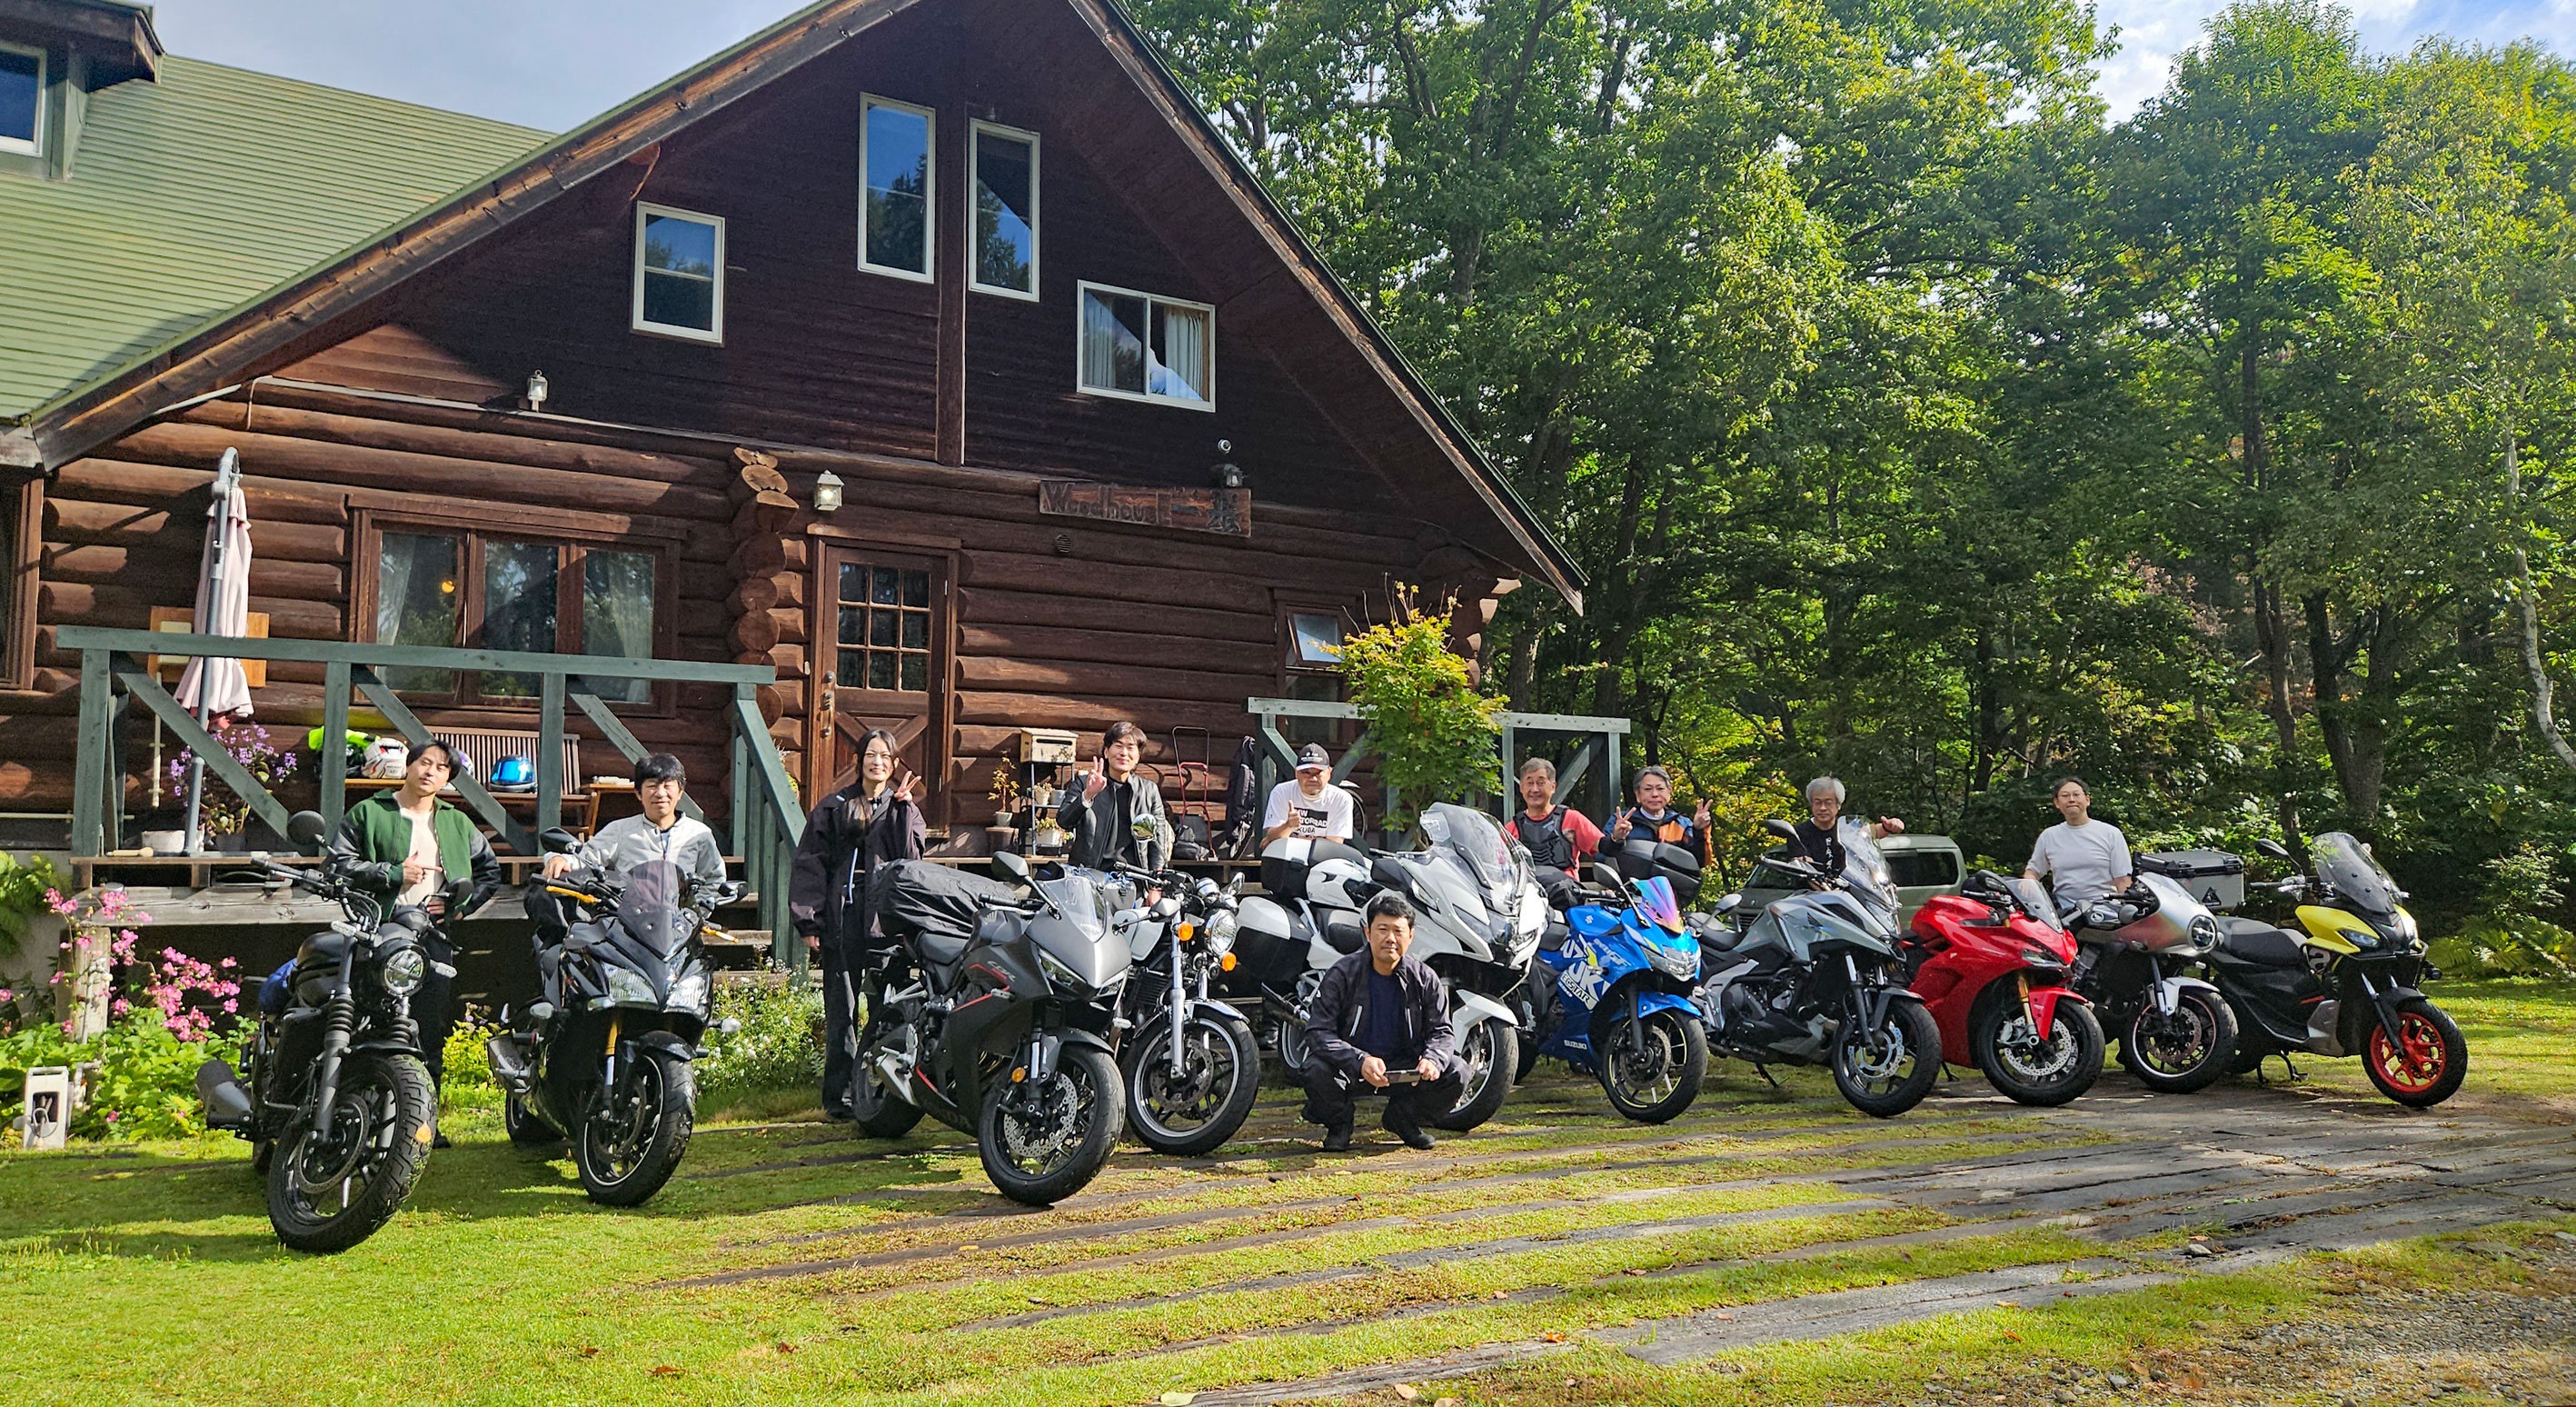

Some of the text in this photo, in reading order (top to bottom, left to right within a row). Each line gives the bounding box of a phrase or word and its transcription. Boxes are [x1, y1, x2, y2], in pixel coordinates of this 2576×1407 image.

[1300, 817, 1328, 828] TORRAD
[1297, 826, 1316, 834] KUBA
[987, 960, 1016, 983] CBR
